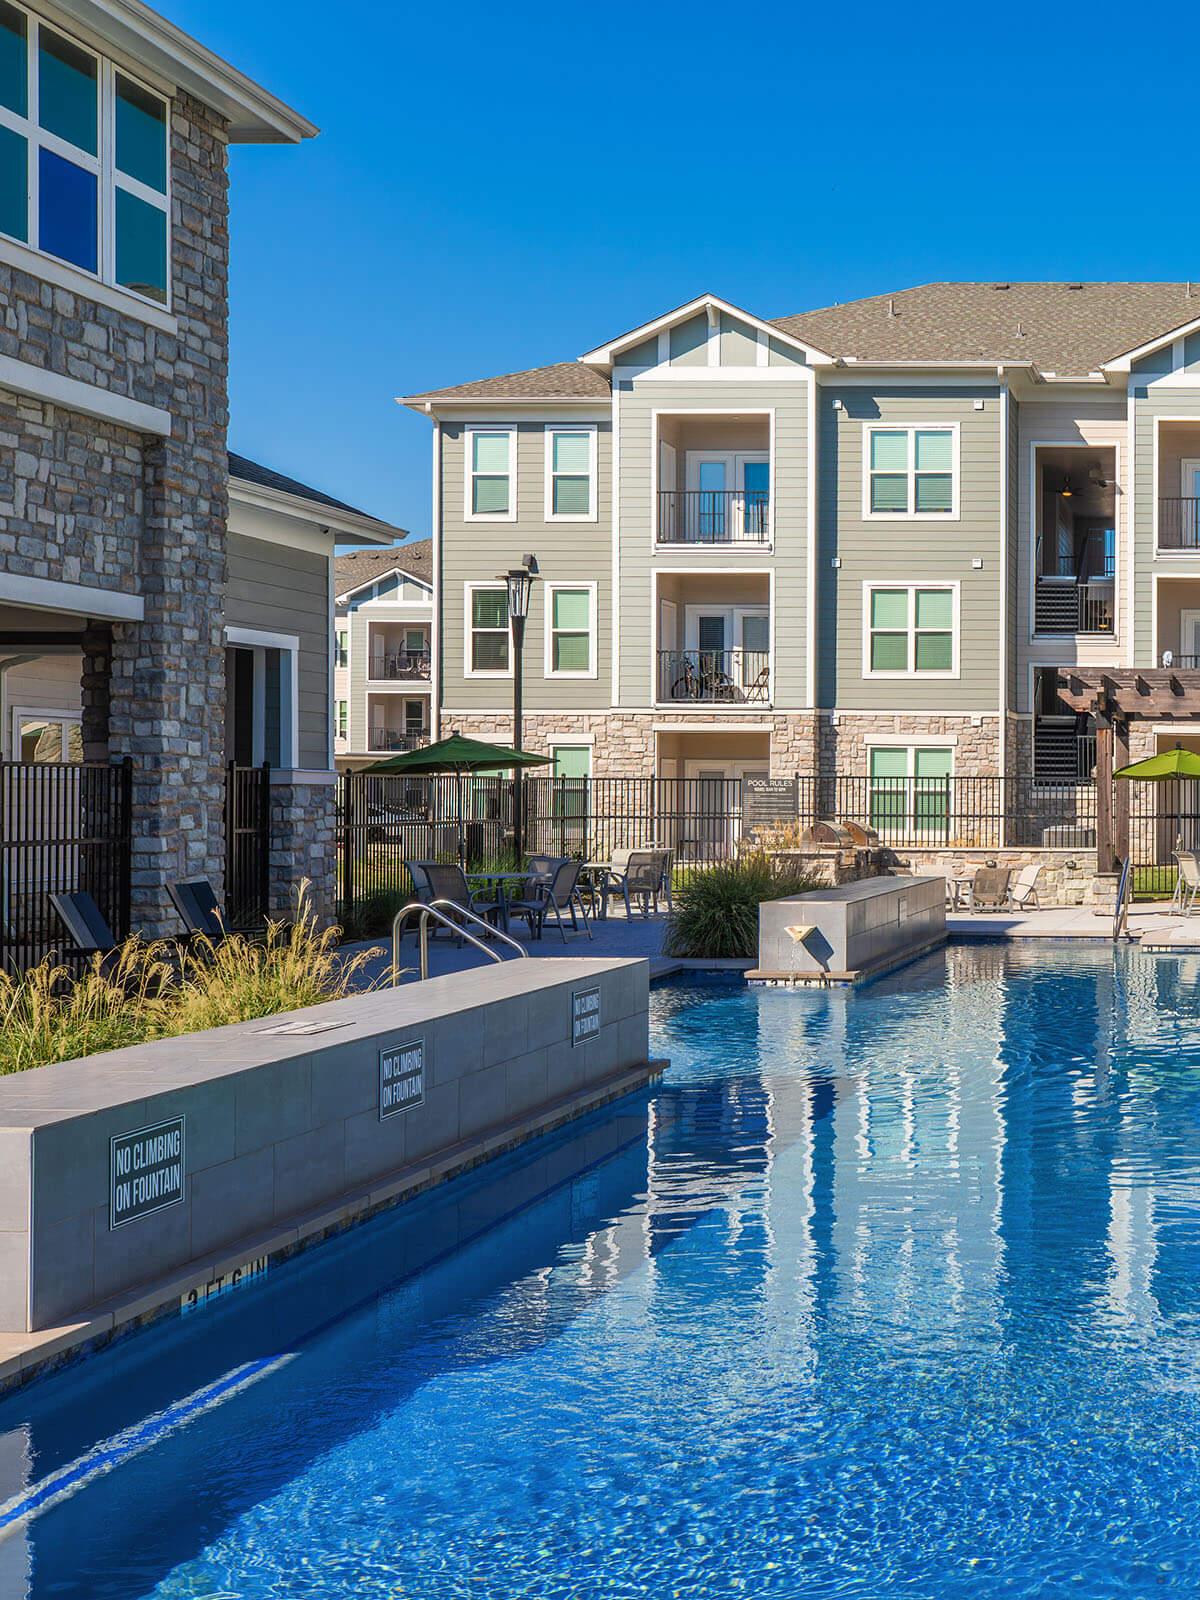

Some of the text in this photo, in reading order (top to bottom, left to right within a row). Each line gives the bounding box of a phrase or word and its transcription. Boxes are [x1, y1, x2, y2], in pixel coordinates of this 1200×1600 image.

[383, 1048, 422, 1080] NO CLIMBING
[383, 1074, 422, 1107] ON FOUNTAIN
[116, 1130, 180, 1176] NO CLIMBING
[116, 1163, 180, 1212] ON FOUNTAIN
